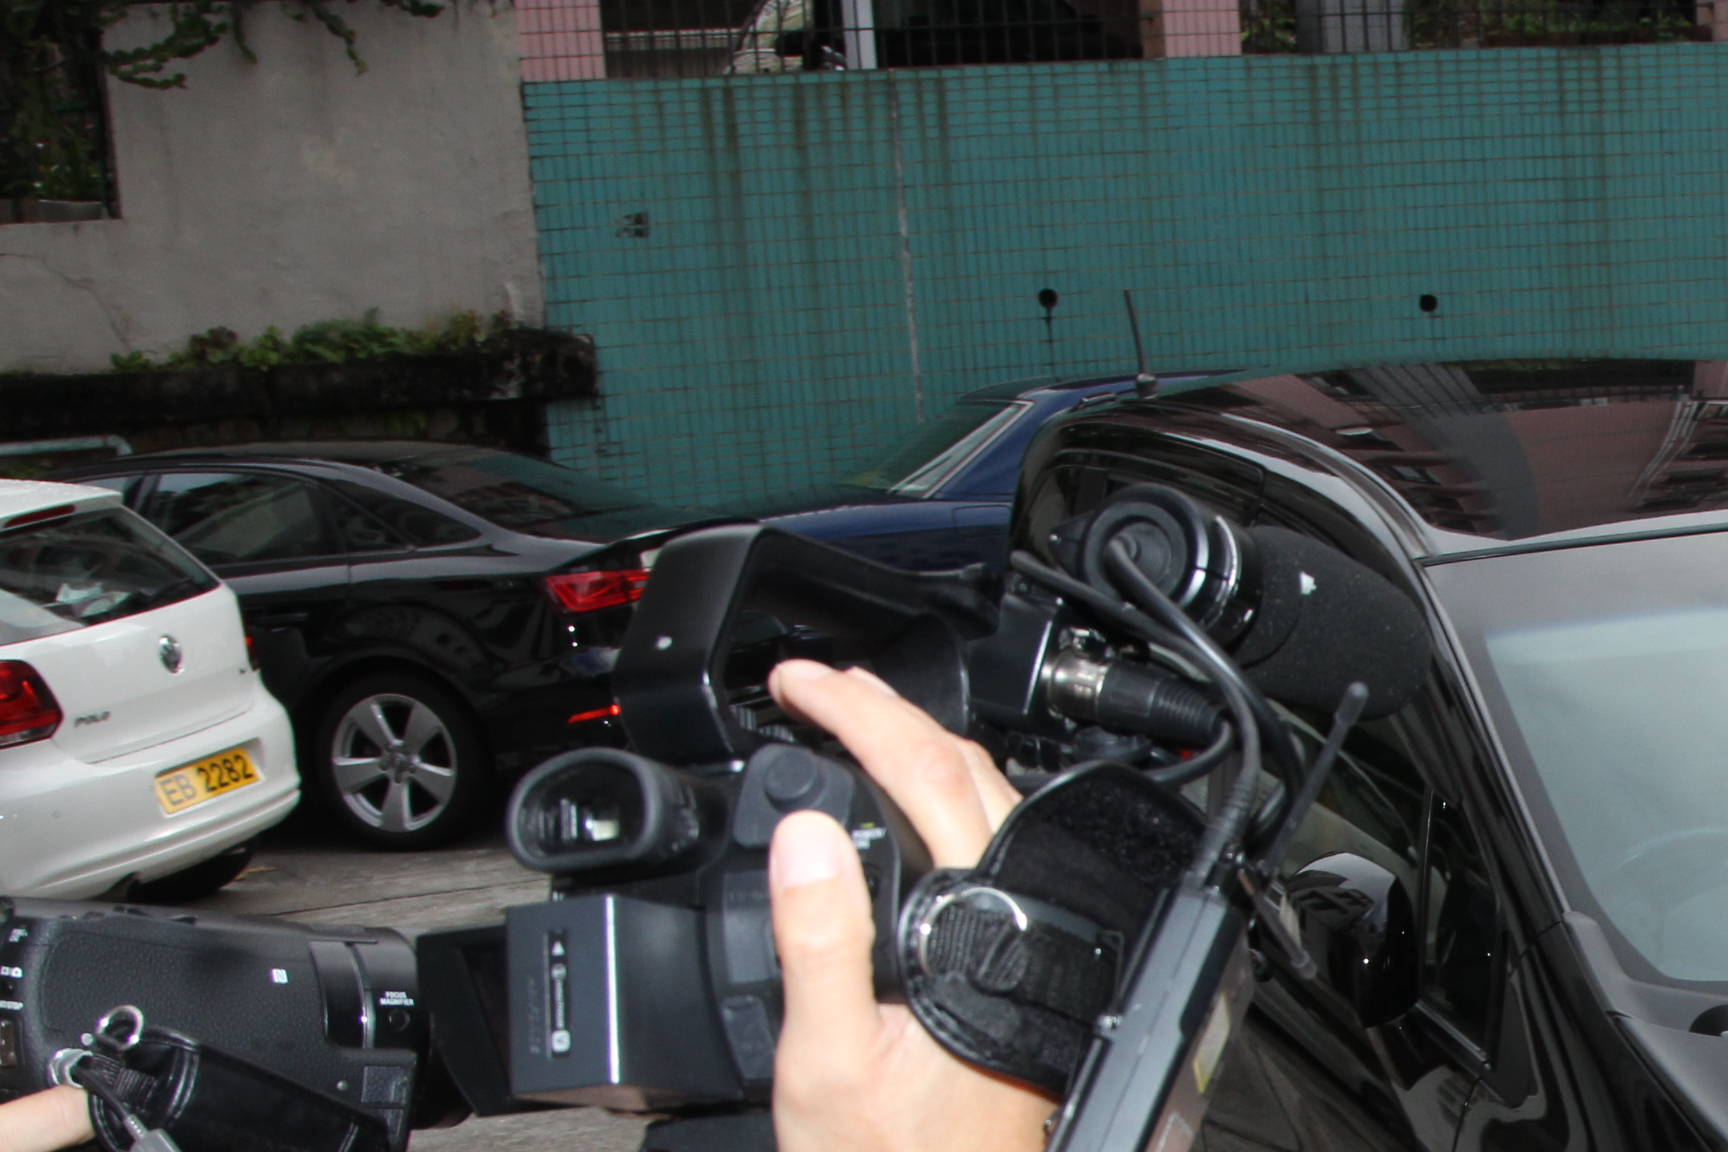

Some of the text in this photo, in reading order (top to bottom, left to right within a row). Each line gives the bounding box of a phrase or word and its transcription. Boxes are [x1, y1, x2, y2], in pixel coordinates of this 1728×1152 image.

[74, 711, 111, 727] POLO
[160, 754, 254, 806] EB 2282
[385, 991, 407, 999] FOCUS
